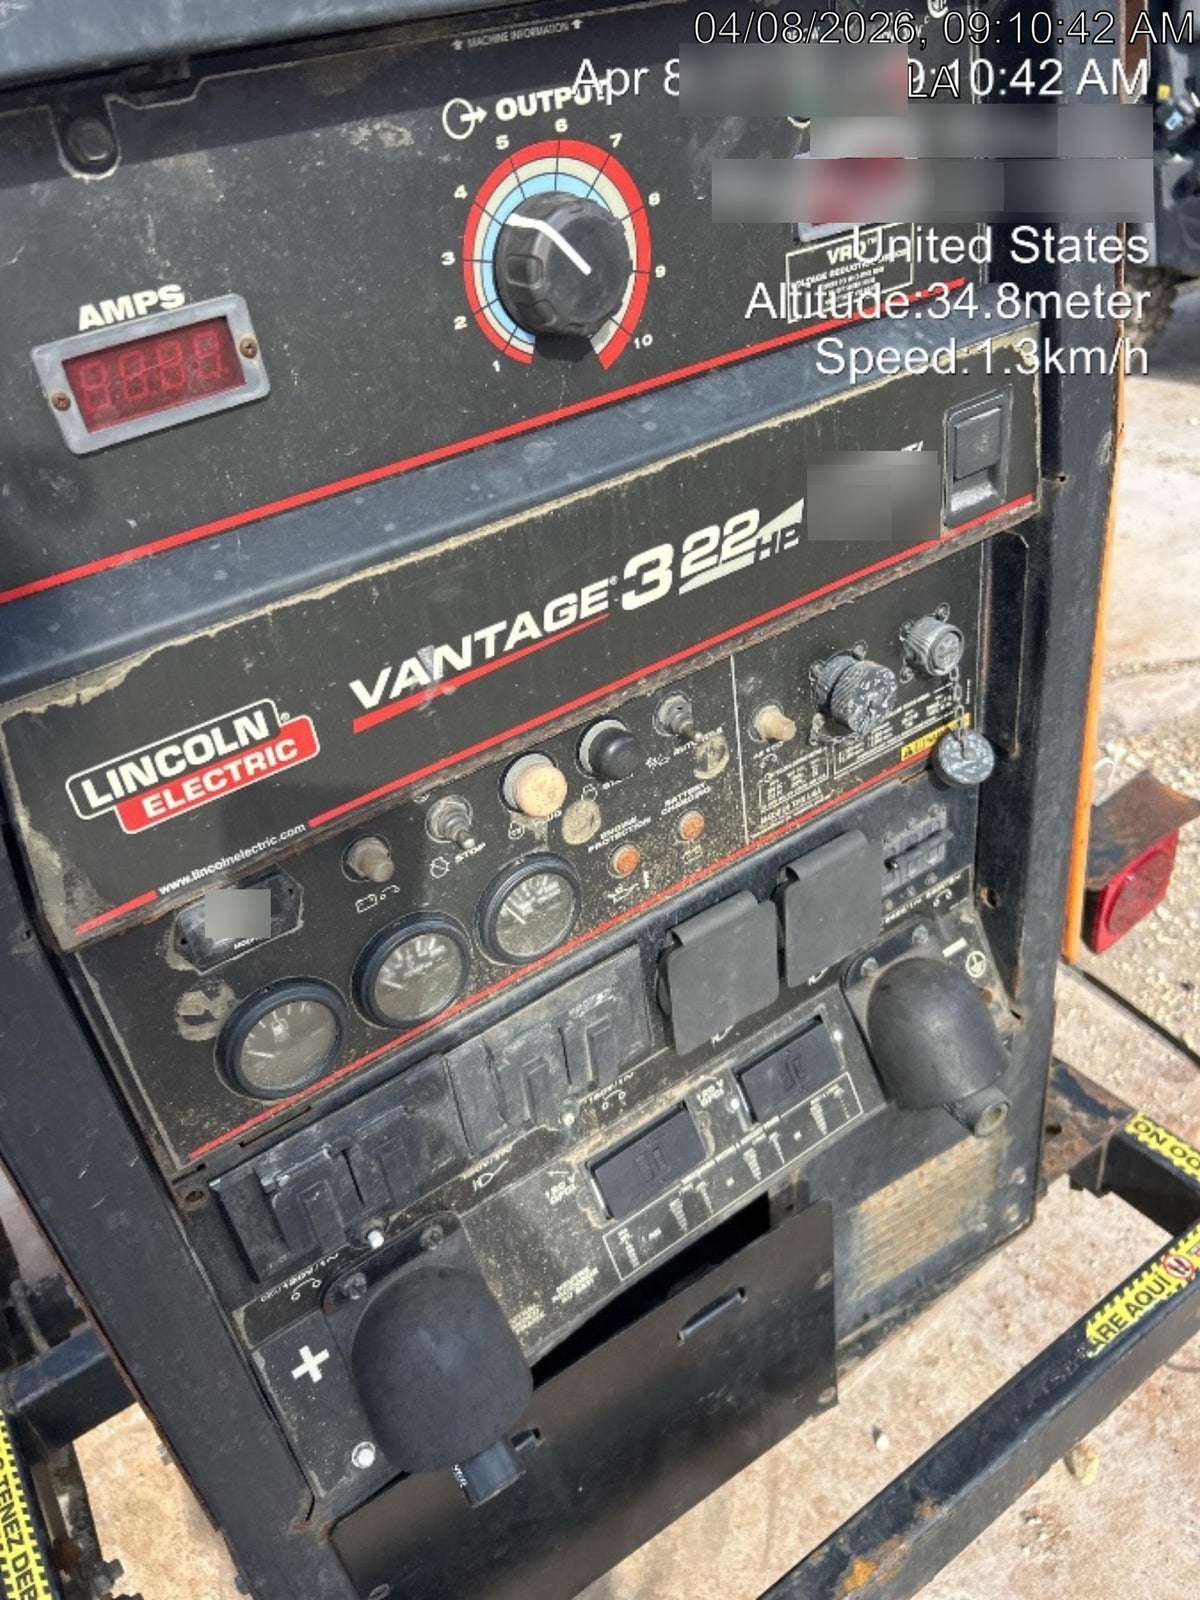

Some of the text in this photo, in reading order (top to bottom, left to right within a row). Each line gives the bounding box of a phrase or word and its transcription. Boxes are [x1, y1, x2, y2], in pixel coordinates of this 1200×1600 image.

[467, 21, 569, 48] MACHINE INFORMATION
[554, 118, 569, 133] 6
[495, 135, 510, 150] 5
[609, 132, 623, 148] 7
[453, 185, 468, 200] 4
[648, 192, 661, 207] 8
[441, 251, 456, 266] 3
[655, 264, 667, 278] 9
[78, 283, 186, 331] AMPS
[453, 315, 468, 330] 2
[634, 334, 654, 350] 10
[492, 359, 501, 373] 1
[80, 710, 270, 809] LINCOLN
[141, 738, 298, 819] ELECTRIC
[660, 785, 712, 816] CHARGING
[664, 781, 707, 808] BATTERY
[587, 816, 652, 853] PROTECTION
[600, 815, 638, 840] ENGINE
[158, 822, 306, 896] www.lincolnelectric.com
[454, 842, 486, 863] STOP
